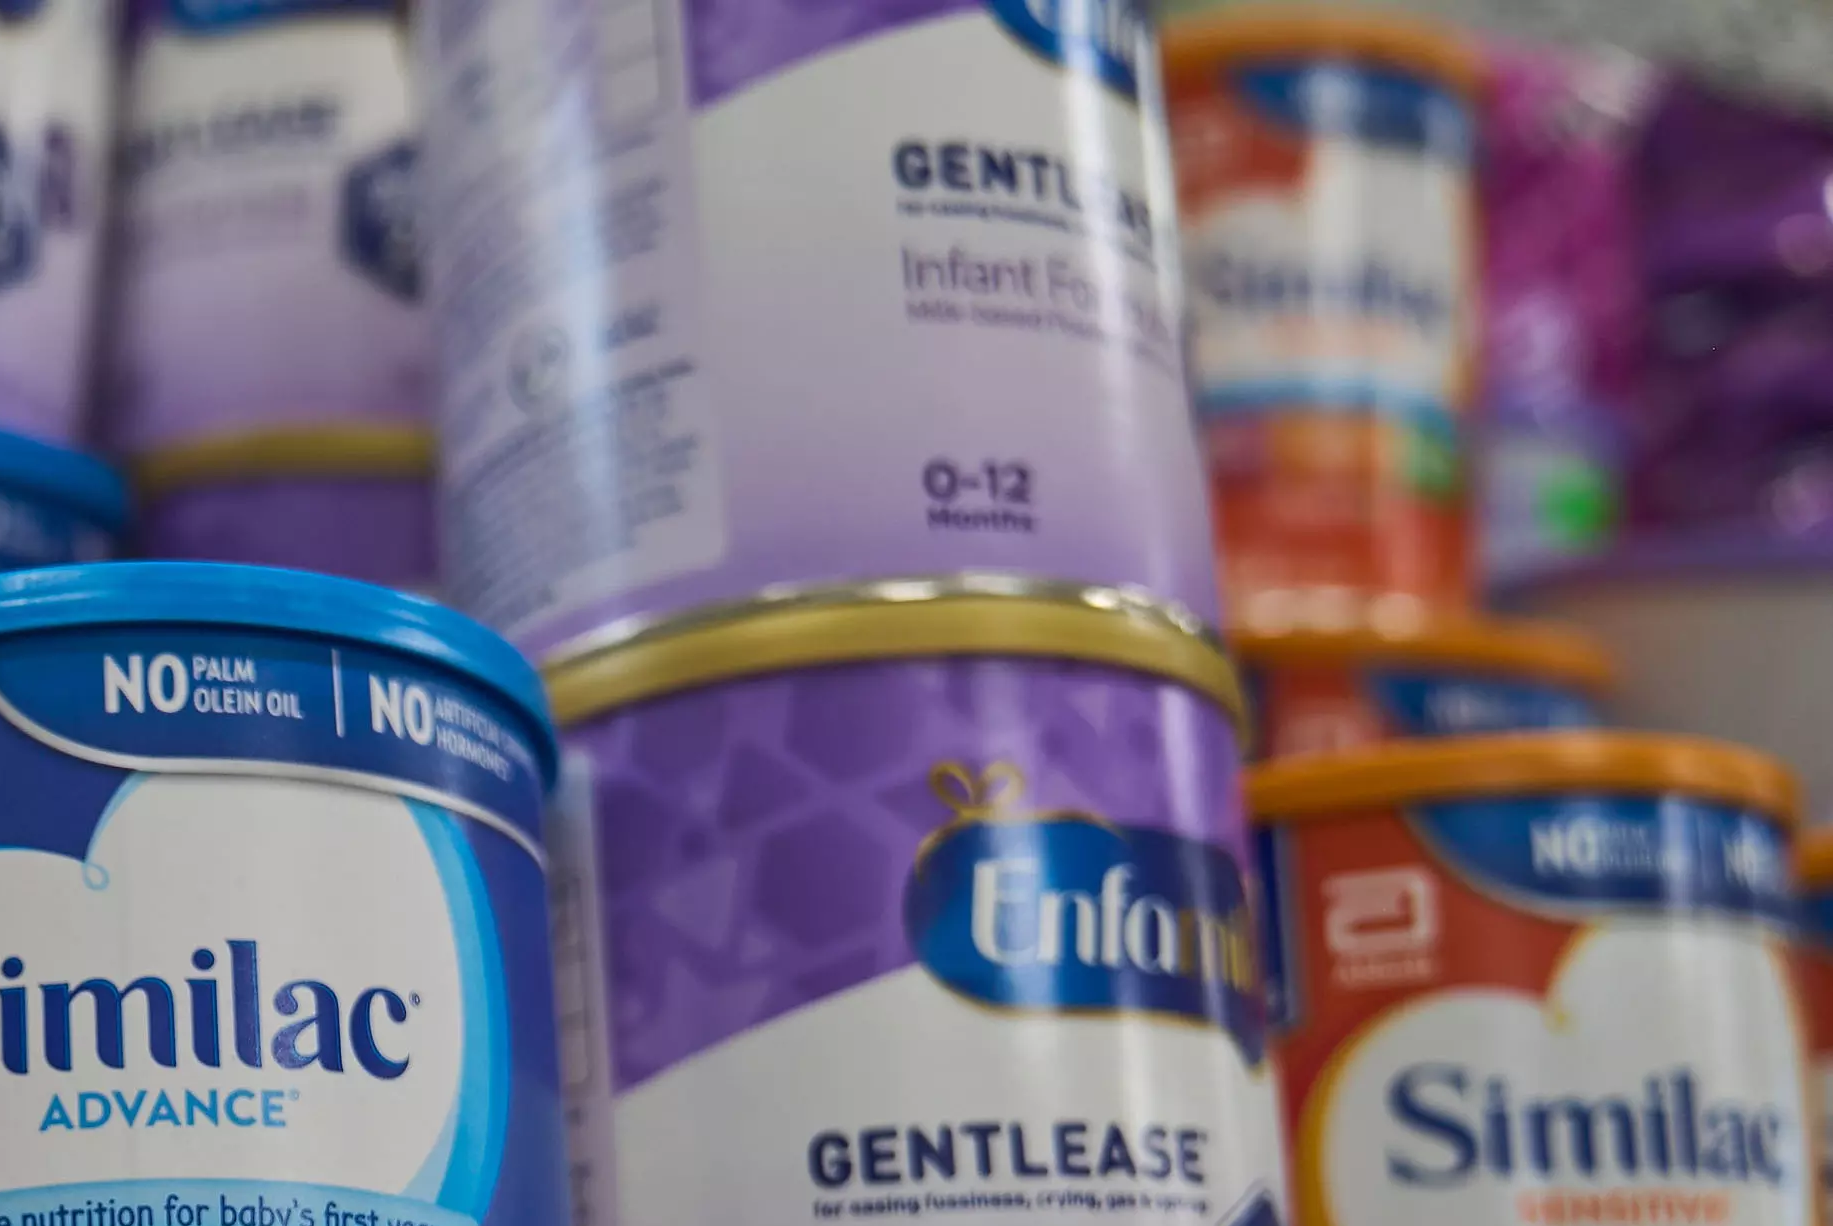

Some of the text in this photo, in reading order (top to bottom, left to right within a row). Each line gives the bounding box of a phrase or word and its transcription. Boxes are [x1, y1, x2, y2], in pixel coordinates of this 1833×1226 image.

[901, 246, 1034, 298] Infant
[921, 461, 1034, 504] 0-12
[103, 653, 190, 714] NO
[193, 655, 256, 684] PALM
[193, 687, 304, 720] OLEIN OIL
[368, 671, 437, 746] NO
[39, 1089, 288, 1132] ADVANCE
[1384, 1060, 1783, 1188] Similac
[808, 1122, 1210, 1190] GENTLEASE
